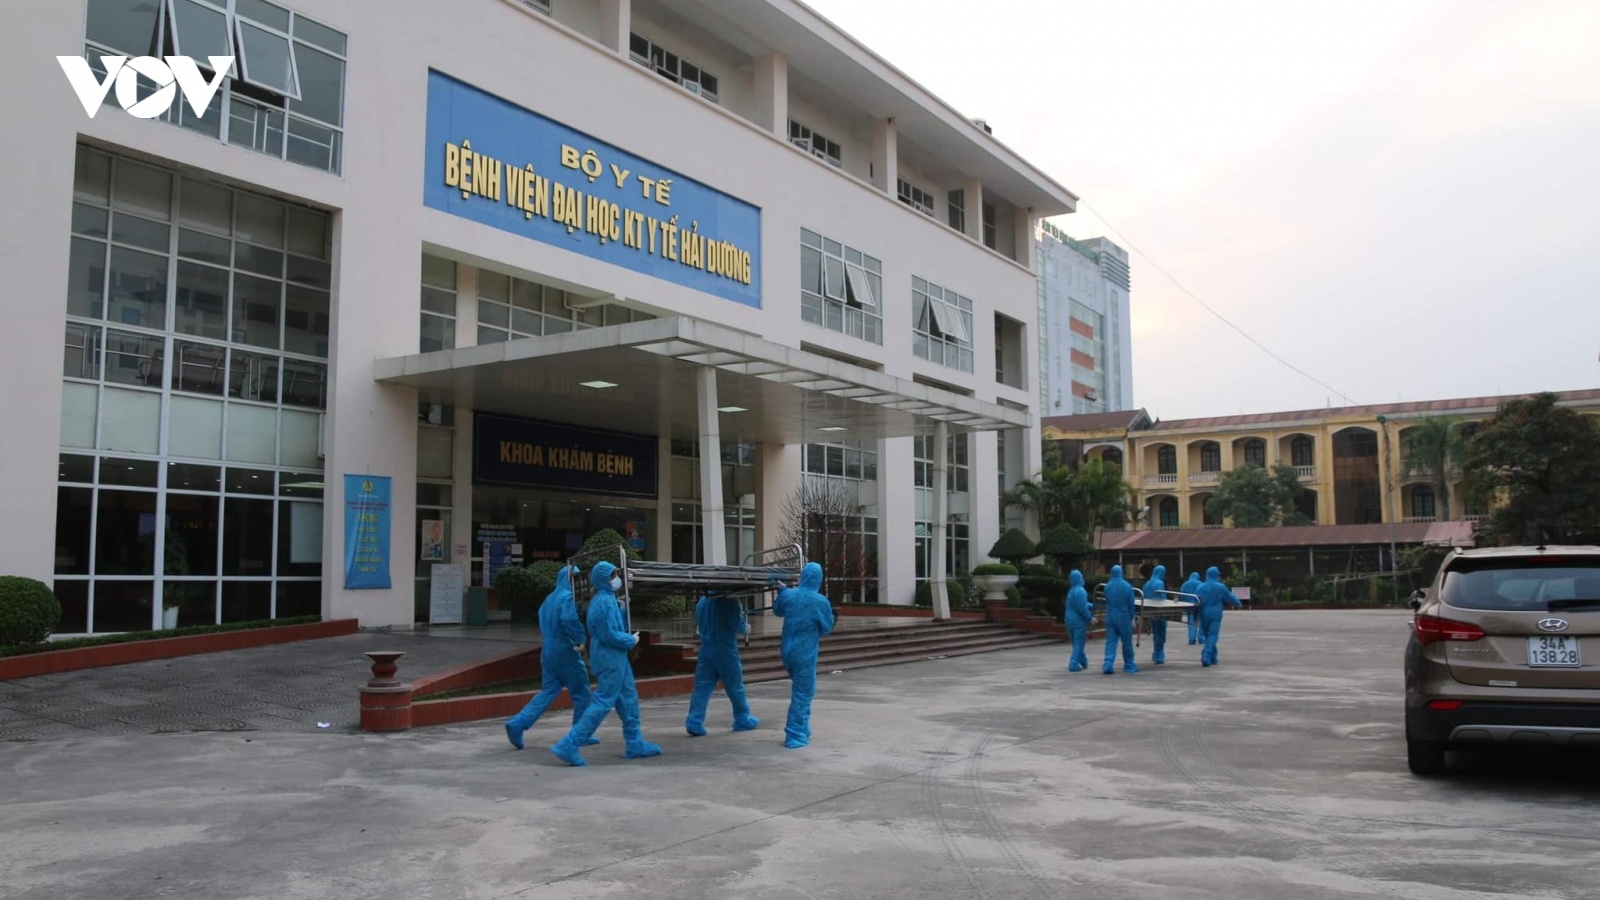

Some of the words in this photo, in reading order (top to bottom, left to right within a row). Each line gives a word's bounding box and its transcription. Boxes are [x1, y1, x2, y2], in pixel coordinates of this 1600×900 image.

[561, 143, 602, 182] BỘ
[610, 164, 630, 188] Y
[638, 174, 673, 207] TẾ
[445, 140, 501, 201] BỆNH
[505, 163, 548, 221] VIỆN
[552, 181, 582, 234] ĐẠI
[586, 194, 619, 245] HỌC
[624, 208, 643, 249] KT
[647, 216, 657, 254] Y
[661, 214, 679, 261] TẾ
[681, 221, 704, 271] HẢI
[707, 239, 750, 286] DƯƠNG
[500, 440, 543, 466] KHOA
[548, 444, 593, 472] KHÁM
[597, 449, 633, 479] BỆNH
[1540, 636, 1566, 650] 34A
